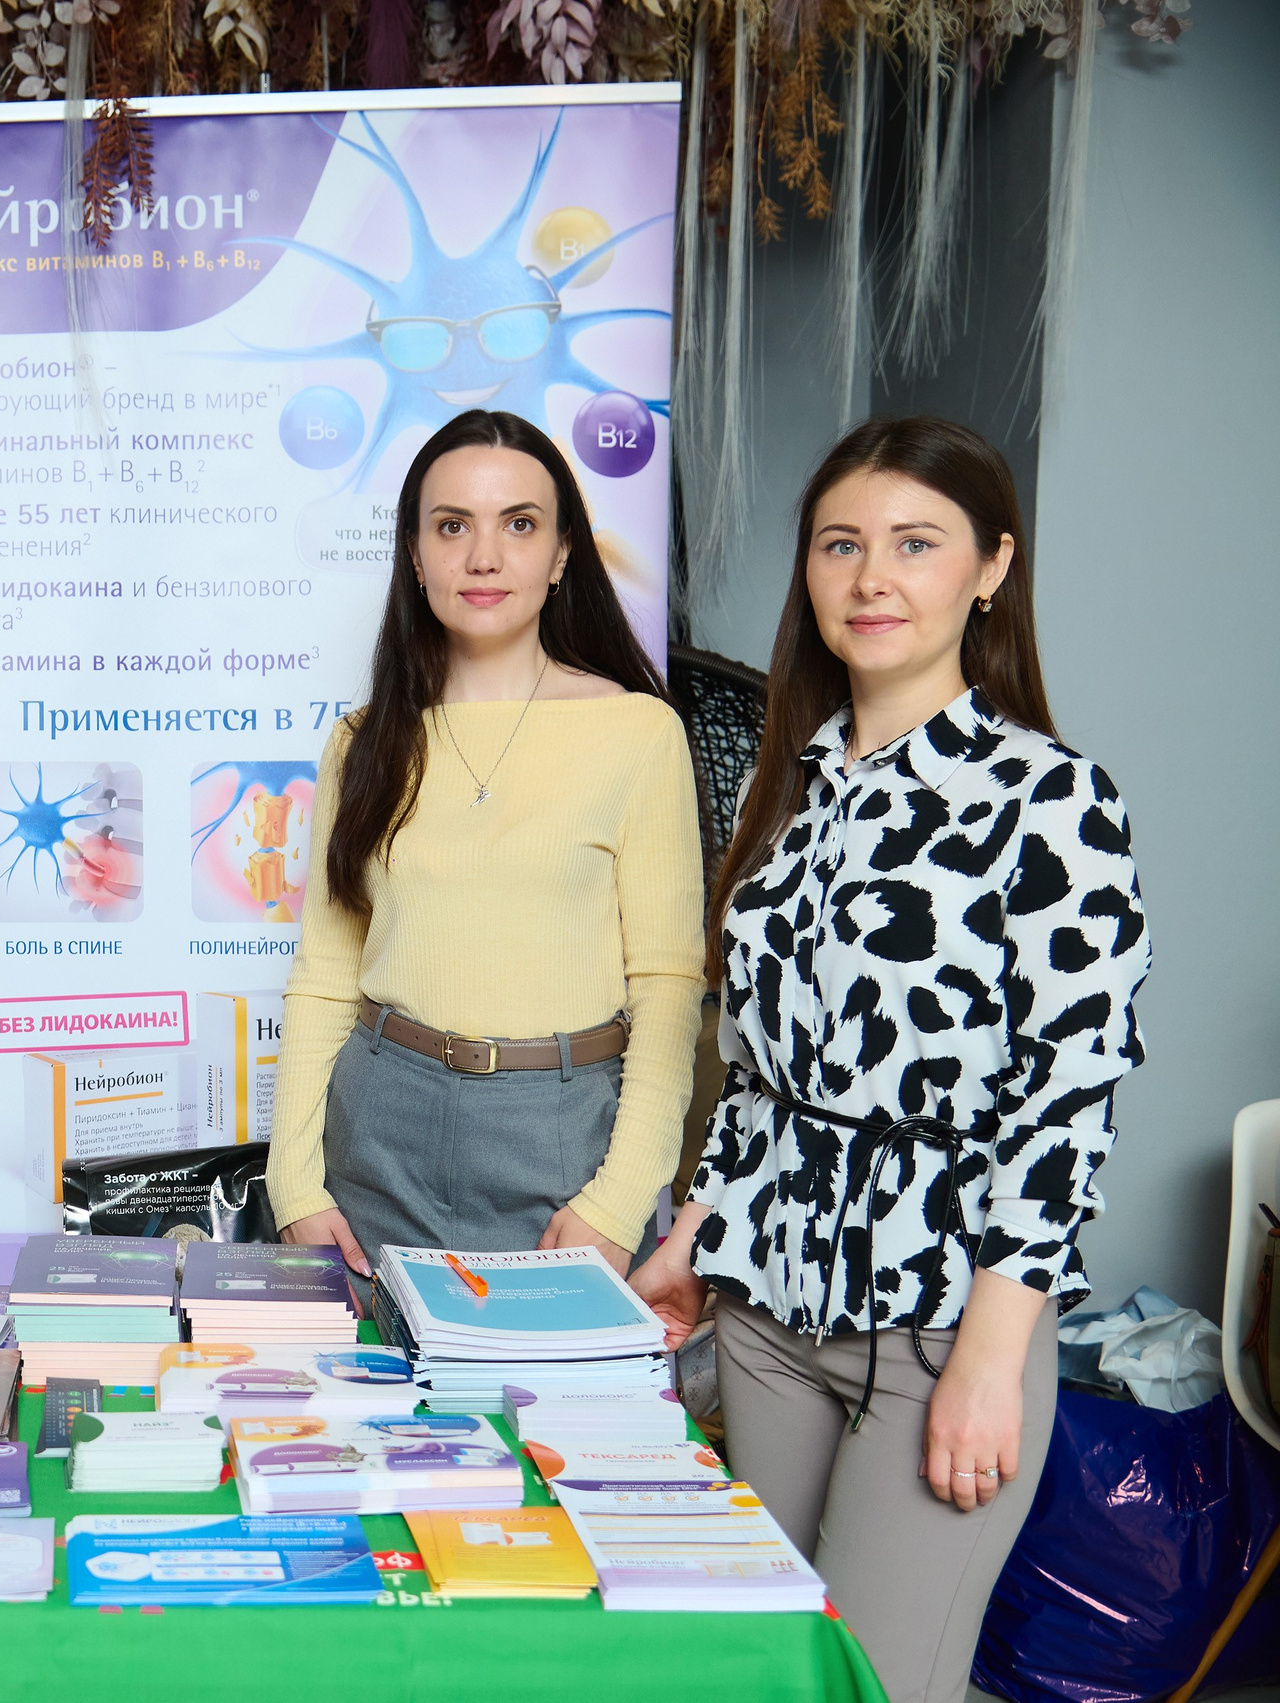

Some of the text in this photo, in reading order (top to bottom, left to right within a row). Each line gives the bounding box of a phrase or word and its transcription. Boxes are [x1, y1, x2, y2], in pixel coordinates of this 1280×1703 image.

[26, 250, 144, 273] витаминов
[103, 385, 175, 413] бренд
[185, 391, 196, 409] в
[131, 430, 255, 451] комплекс
[18, 503, 49, 525] 55
[59, 506, 102, 525] лет
[109, 505, 278, 525] клинического
[335, 529, 365, 541] что
[319, 549, 339, 562] не
[133, 579, 147, 597] и
[156, 574, 312, 598] бензилового
[93, 653, 106, 671] в
[116, 648, 212, 675] каждой
[20, 700, 258, 740] Применяется
[275, 709, 293, 730] в
[5, 939, 123, 956] БОЛЬ В СПИНЕ
[39, 1010, 179, 1035] ЛИДОКАИНА!
[74, 1106, 167, 1125] Пиридоксин Тиамин
[74, 1122, 144, 1138] Для приема внутрь
[74, 1137, 105, 1147] Хранить
[106, 1135, 120, 1144] при
[121, 1129, 165, 1142] температуре
[74, 1147, 105, 1156] Хранить
[112, 1138, 159, 1150] недоступном
[160, 1135, 172, 1143] для
[173, 1133, 192, 1142] детей
[104, 1170, 189, 1184] Забота о ЖКТ
[104, 1186, 171, 1196] профилактика
[106, 1205, 136, 1215] кишки
[138, 1206, 144, 1214] с
[430, 1251, 588, 1262] НВРОЛОГИЯ
